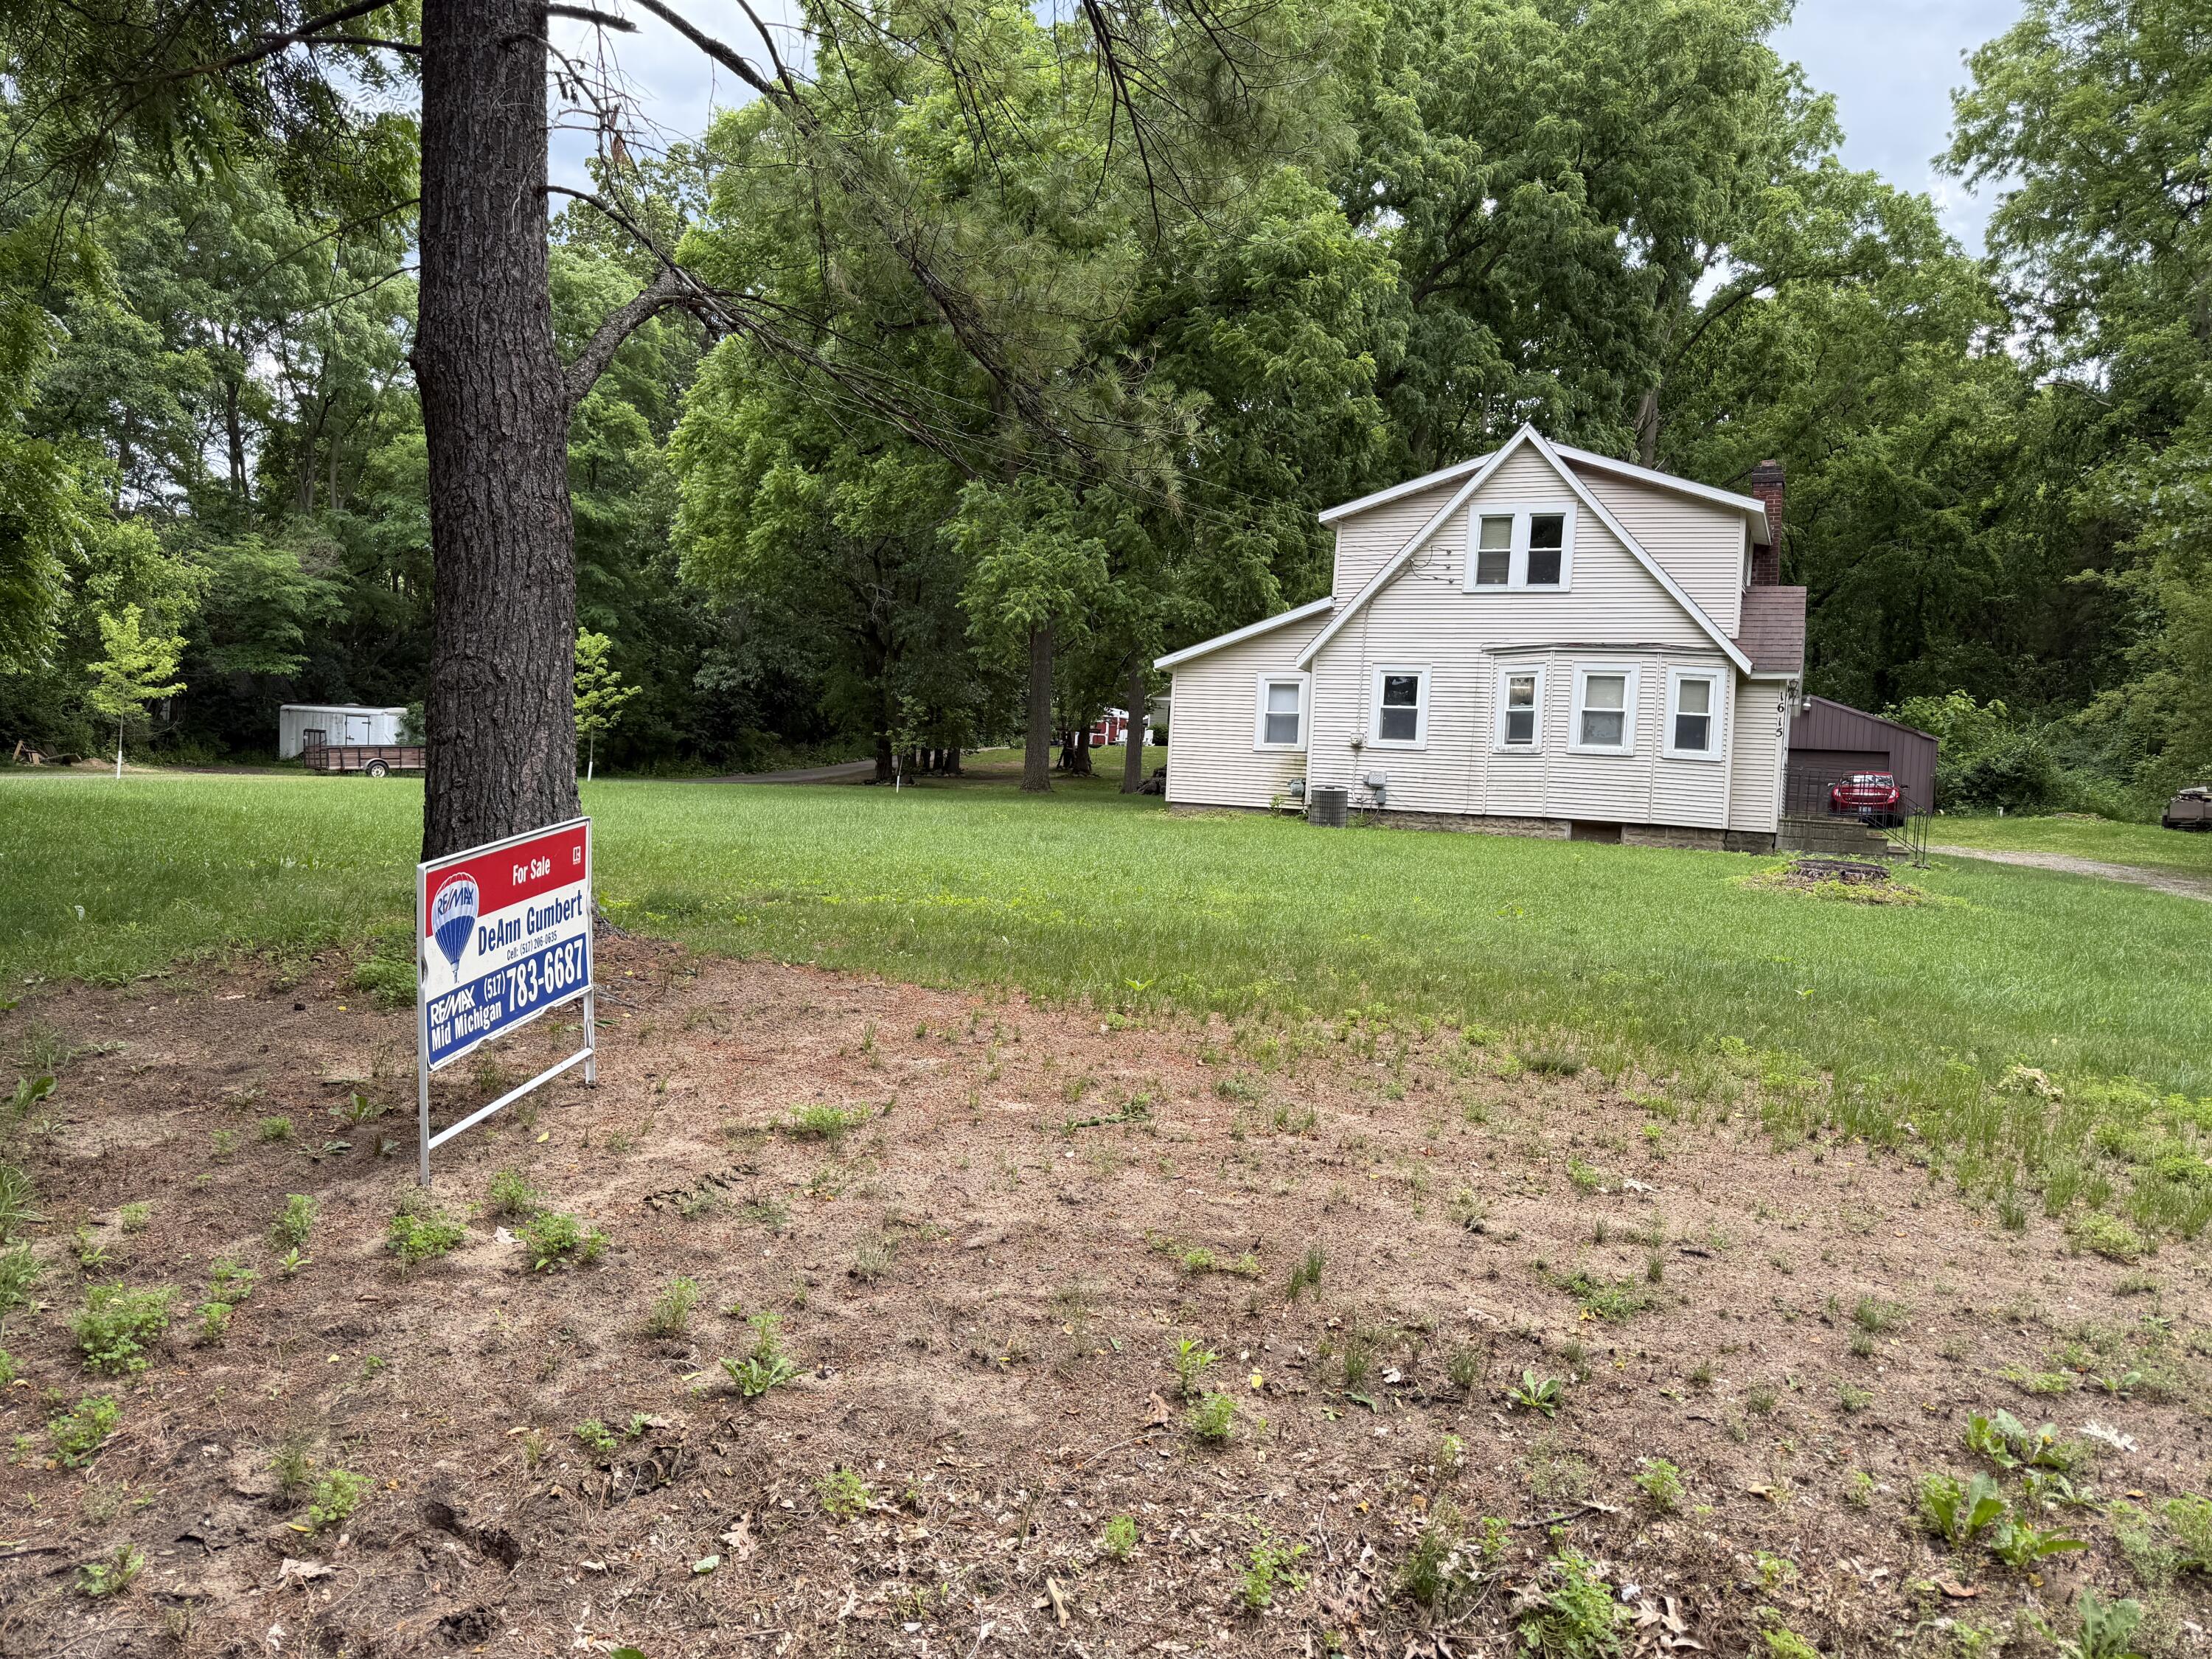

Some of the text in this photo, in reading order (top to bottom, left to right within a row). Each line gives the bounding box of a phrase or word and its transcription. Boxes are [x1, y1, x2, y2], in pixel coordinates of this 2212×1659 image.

[1775, 692, 1784, 737] 1615
[512, 855, 551, 886] For Sale
[437, 887, 474, 917] RE/MAX
[478, 890, 582, 957] DeAnn Gumbert
[507, 947, 519, 961] Cell:
[520, 938, 533, 956] (517)
[484, 939, 584, 1012] (517) 783-6687
[430, 985, 476, 1027] RE/MAX
[431, 1001, 502, 1052] Mid Michigan
